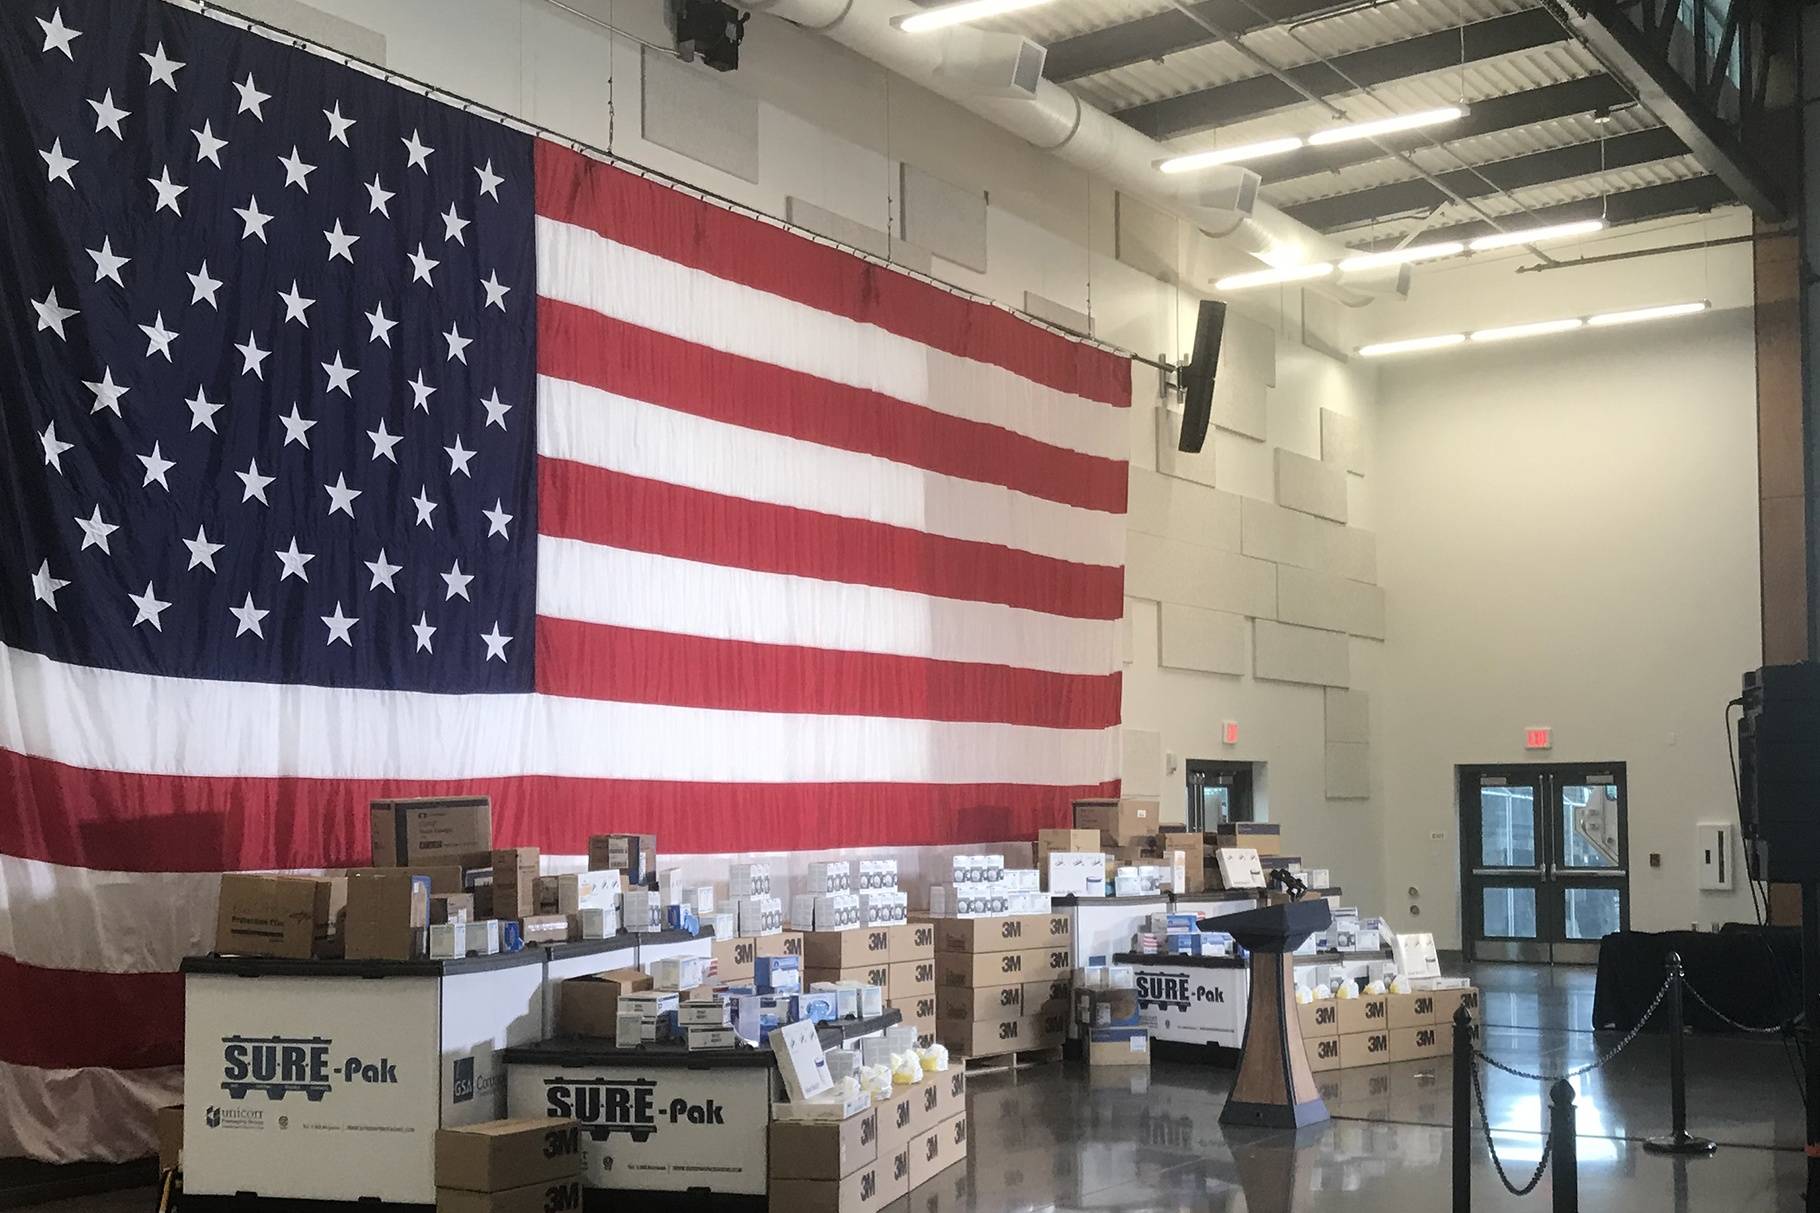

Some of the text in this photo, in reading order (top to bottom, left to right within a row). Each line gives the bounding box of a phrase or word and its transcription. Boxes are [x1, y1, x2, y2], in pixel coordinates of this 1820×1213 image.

[1002, 922, 1021, 938] 3M
[1050, 918, 1068, 935] 3M
[869, 932, 887, 951] 3M
[915, 928, 932, 946] 3M
[735, 943, 752, 965] 3M
[784, 938, 802, 956] 3M
[1002, 955, 1021, 973] 3M
[1050, 952, 1069, 969] 3M
[868, 969, 886, 986] 3M
[915, 964, 932, 982] 3M
[1001, 988, 1019, 1006] 3M
[1050, 982, 1068, 1000] 3M
[917, 999, 934, 1017] 3M
[1316, 1006, 1335, 1025] 3M
[1365, 1002, 1384, 1019] 3M
[1415, 998, 1433, 1015] 3M
[1000, 1021, 1018, 1039] 3M
[1416, 1030, 1435, 1047] 3M
[1318, 1040, 1338, 1059] 3M
[1368, 1035, 1387, 1053] 3M
[455, 1080, 473, 1096] GSA
[952, 1072, 964, 1098] 3M
[924, 1085, 937, 1112] 3M
[897, 1100, 910, 1128] 3M
[861, 1115, 875, 1146] 3M
[954, 1119, 966, 1144] 3M
[543, 1127, 578, 1159] 3M
[926, 1134, 938, 1161] 3M
[894, 1151, 907, 1180] 3M
[861, 1170, 875, 1201] 3M
[543, 1183, 579, 1213] 3M
